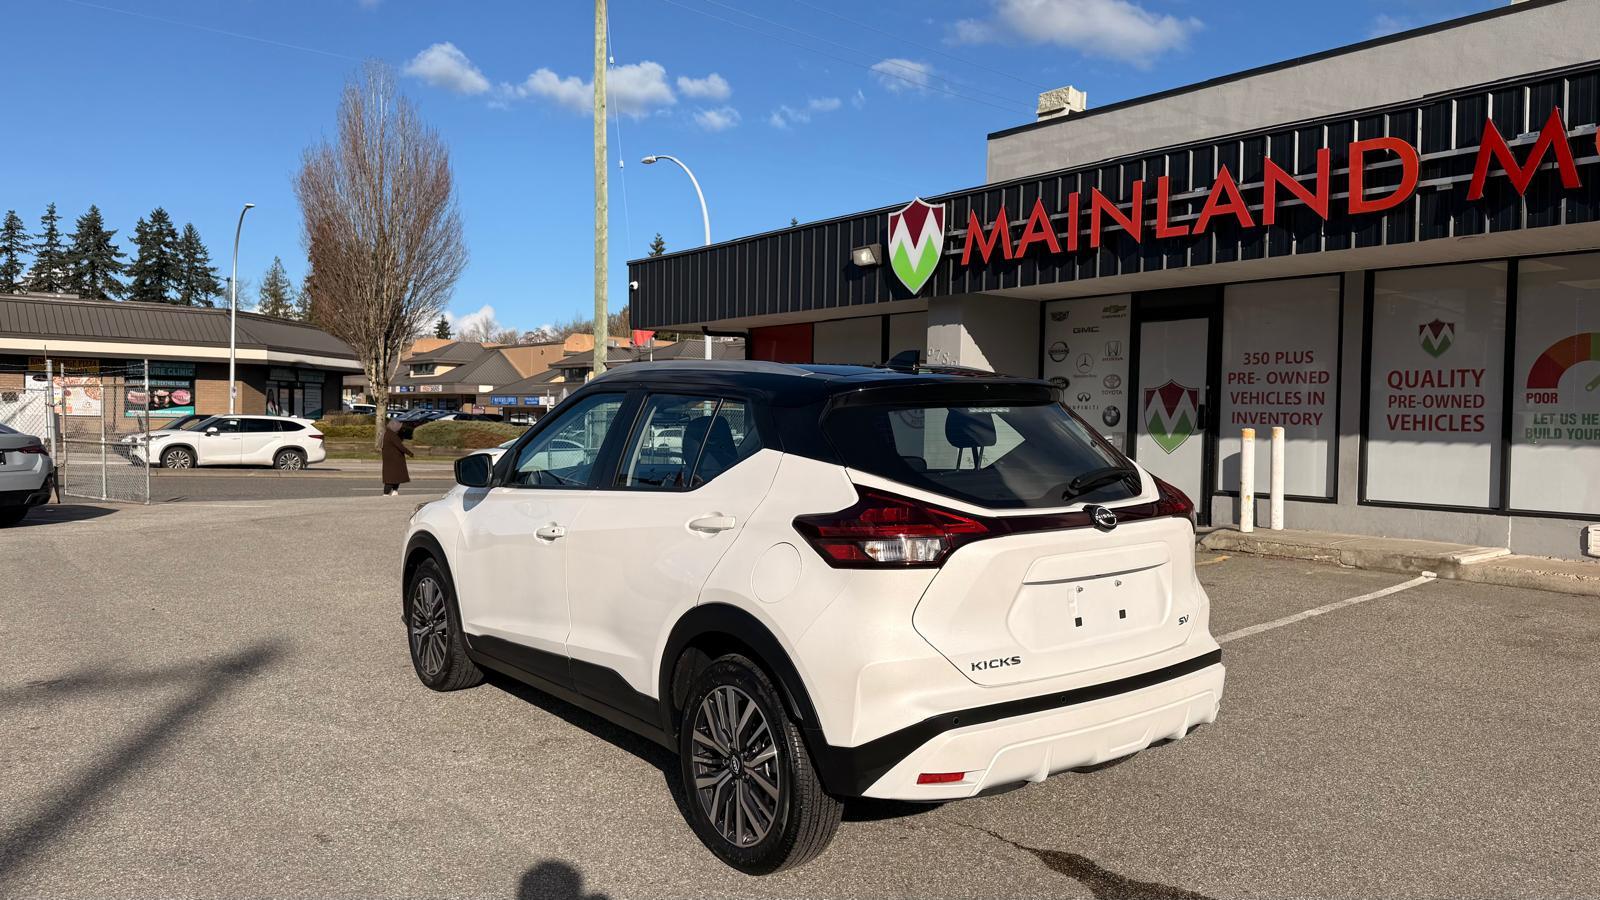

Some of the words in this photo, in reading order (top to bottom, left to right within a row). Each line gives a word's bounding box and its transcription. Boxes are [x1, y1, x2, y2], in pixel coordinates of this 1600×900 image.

[961, 137, 1420, 265] MAINLAND
[1466, 105, 1600, 201] M
[1072, 326, 1100, 334] GMC
[1243, 351, 1270, 366] 350
[1275, 350, 1314, 365] PLUS
[128, 368, 166, 377] DENURE
[168, 368, 193, 378] CLINIC
[1266, 370, 1330, 385] OWNED
[1387, 368, 1486, 391] QUALITY
[1230, 391, 1302, 406] VEHICLES
[1307, 391, 1325, 406] IN
[1388, 394, 1485, 409] PRE-OWNED
[1526, 392, 1558, 404] POOR
[1231, 411, 1323, 426] INVENTORY
[1387, 414, 1485, 433] VEHICLES
[1533, 413, 1556, 425] LET
[1559, 413, 1577, 425] US
[1525, 427, 1562, 440] BUILD
[1566, 427, 1600, 440] YOUR
[1178, 615, 1190, 626] SV
[971, 655, 1022, 672] KICKS
